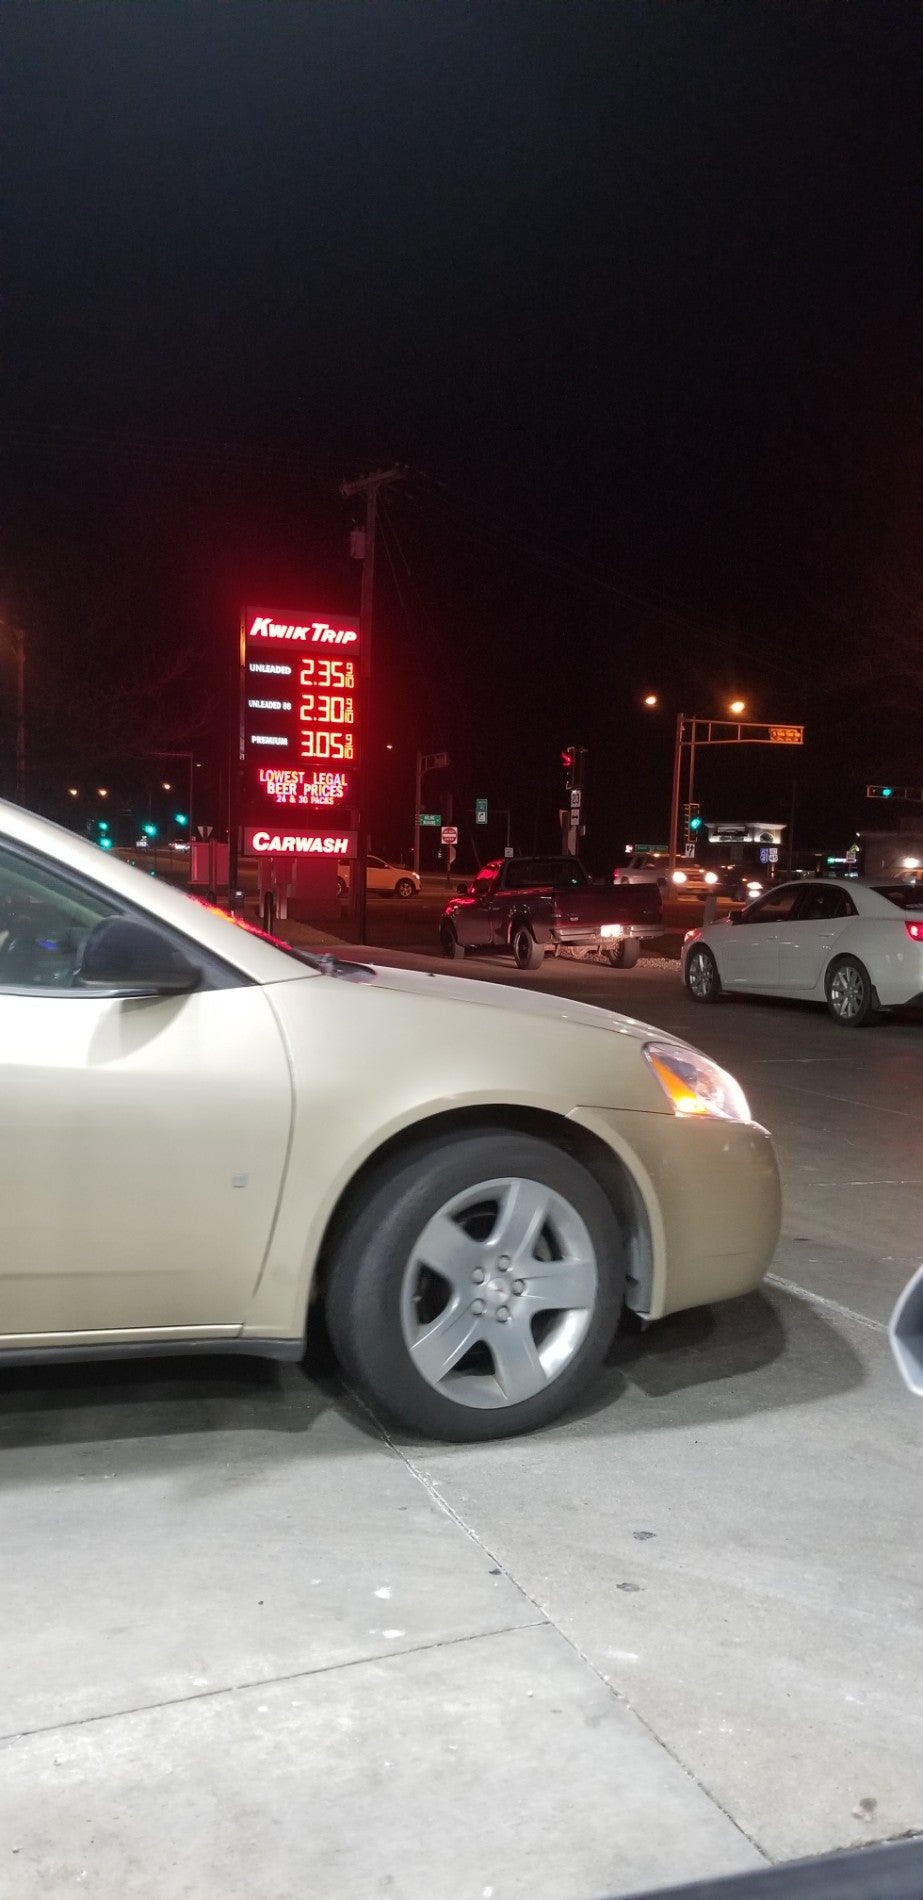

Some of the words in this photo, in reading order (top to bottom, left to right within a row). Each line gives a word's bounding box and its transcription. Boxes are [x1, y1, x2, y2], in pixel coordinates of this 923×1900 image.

[250, 617, 310, 641] KWIK
[311, 623, 357, 644] TRIP
[250, 664, 291, 675] UNLEADED
[300, 659, 344, 688] 2.35
[345, 662, 353, 674] 9
[344, 675, 354, 688] 10
[248, 700, 281, 709] UNLEADED
[300, 694, 344, 722] 2.30
[345, 698, 353, 710] 9
[345, 711, 353, 723] 10
[251, 736, 288, 745] PREMIUM
[301, 731, 343, 758] 3.05
[345, 734, 353, 746] 9
[345, 746, 353, 759] 10
[259, 769, 305, 784] LOWEST
[313, 772, 348, 786] LEGAL
[267, 782, 297, 795] BEER
[304, 783, 344, 798] PRICES
[298, 796, 308, 804] 30
[253, 832, 348, 853] CARWASH
